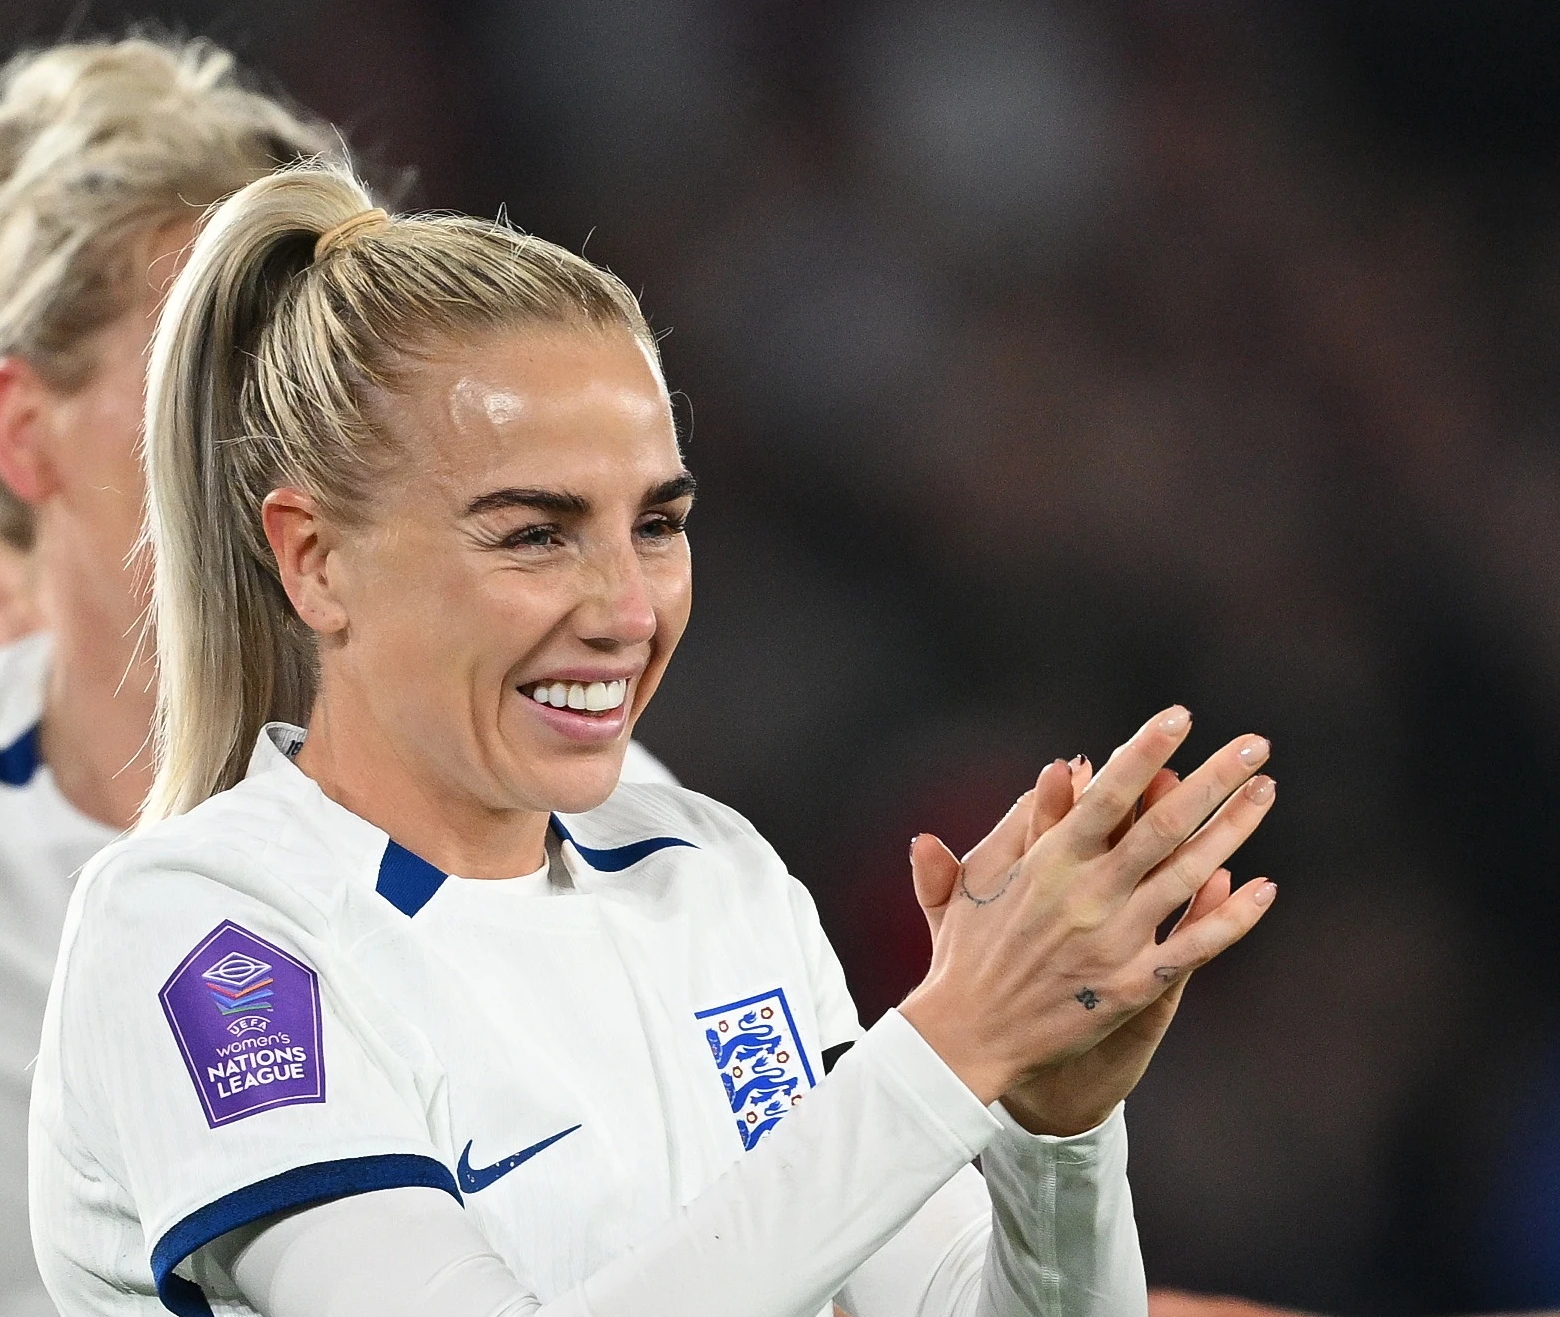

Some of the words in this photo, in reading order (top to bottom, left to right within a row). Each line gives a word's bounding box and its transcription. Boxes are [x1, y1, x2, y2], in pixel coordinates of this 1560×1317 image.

[229, 1018, 267, 1035] UEFA
[215, 1031, 291, 1058] women's
[206, 1046, 307, 1083] NATIONS
[217, 1063, 305, 1099] LEAGUE
